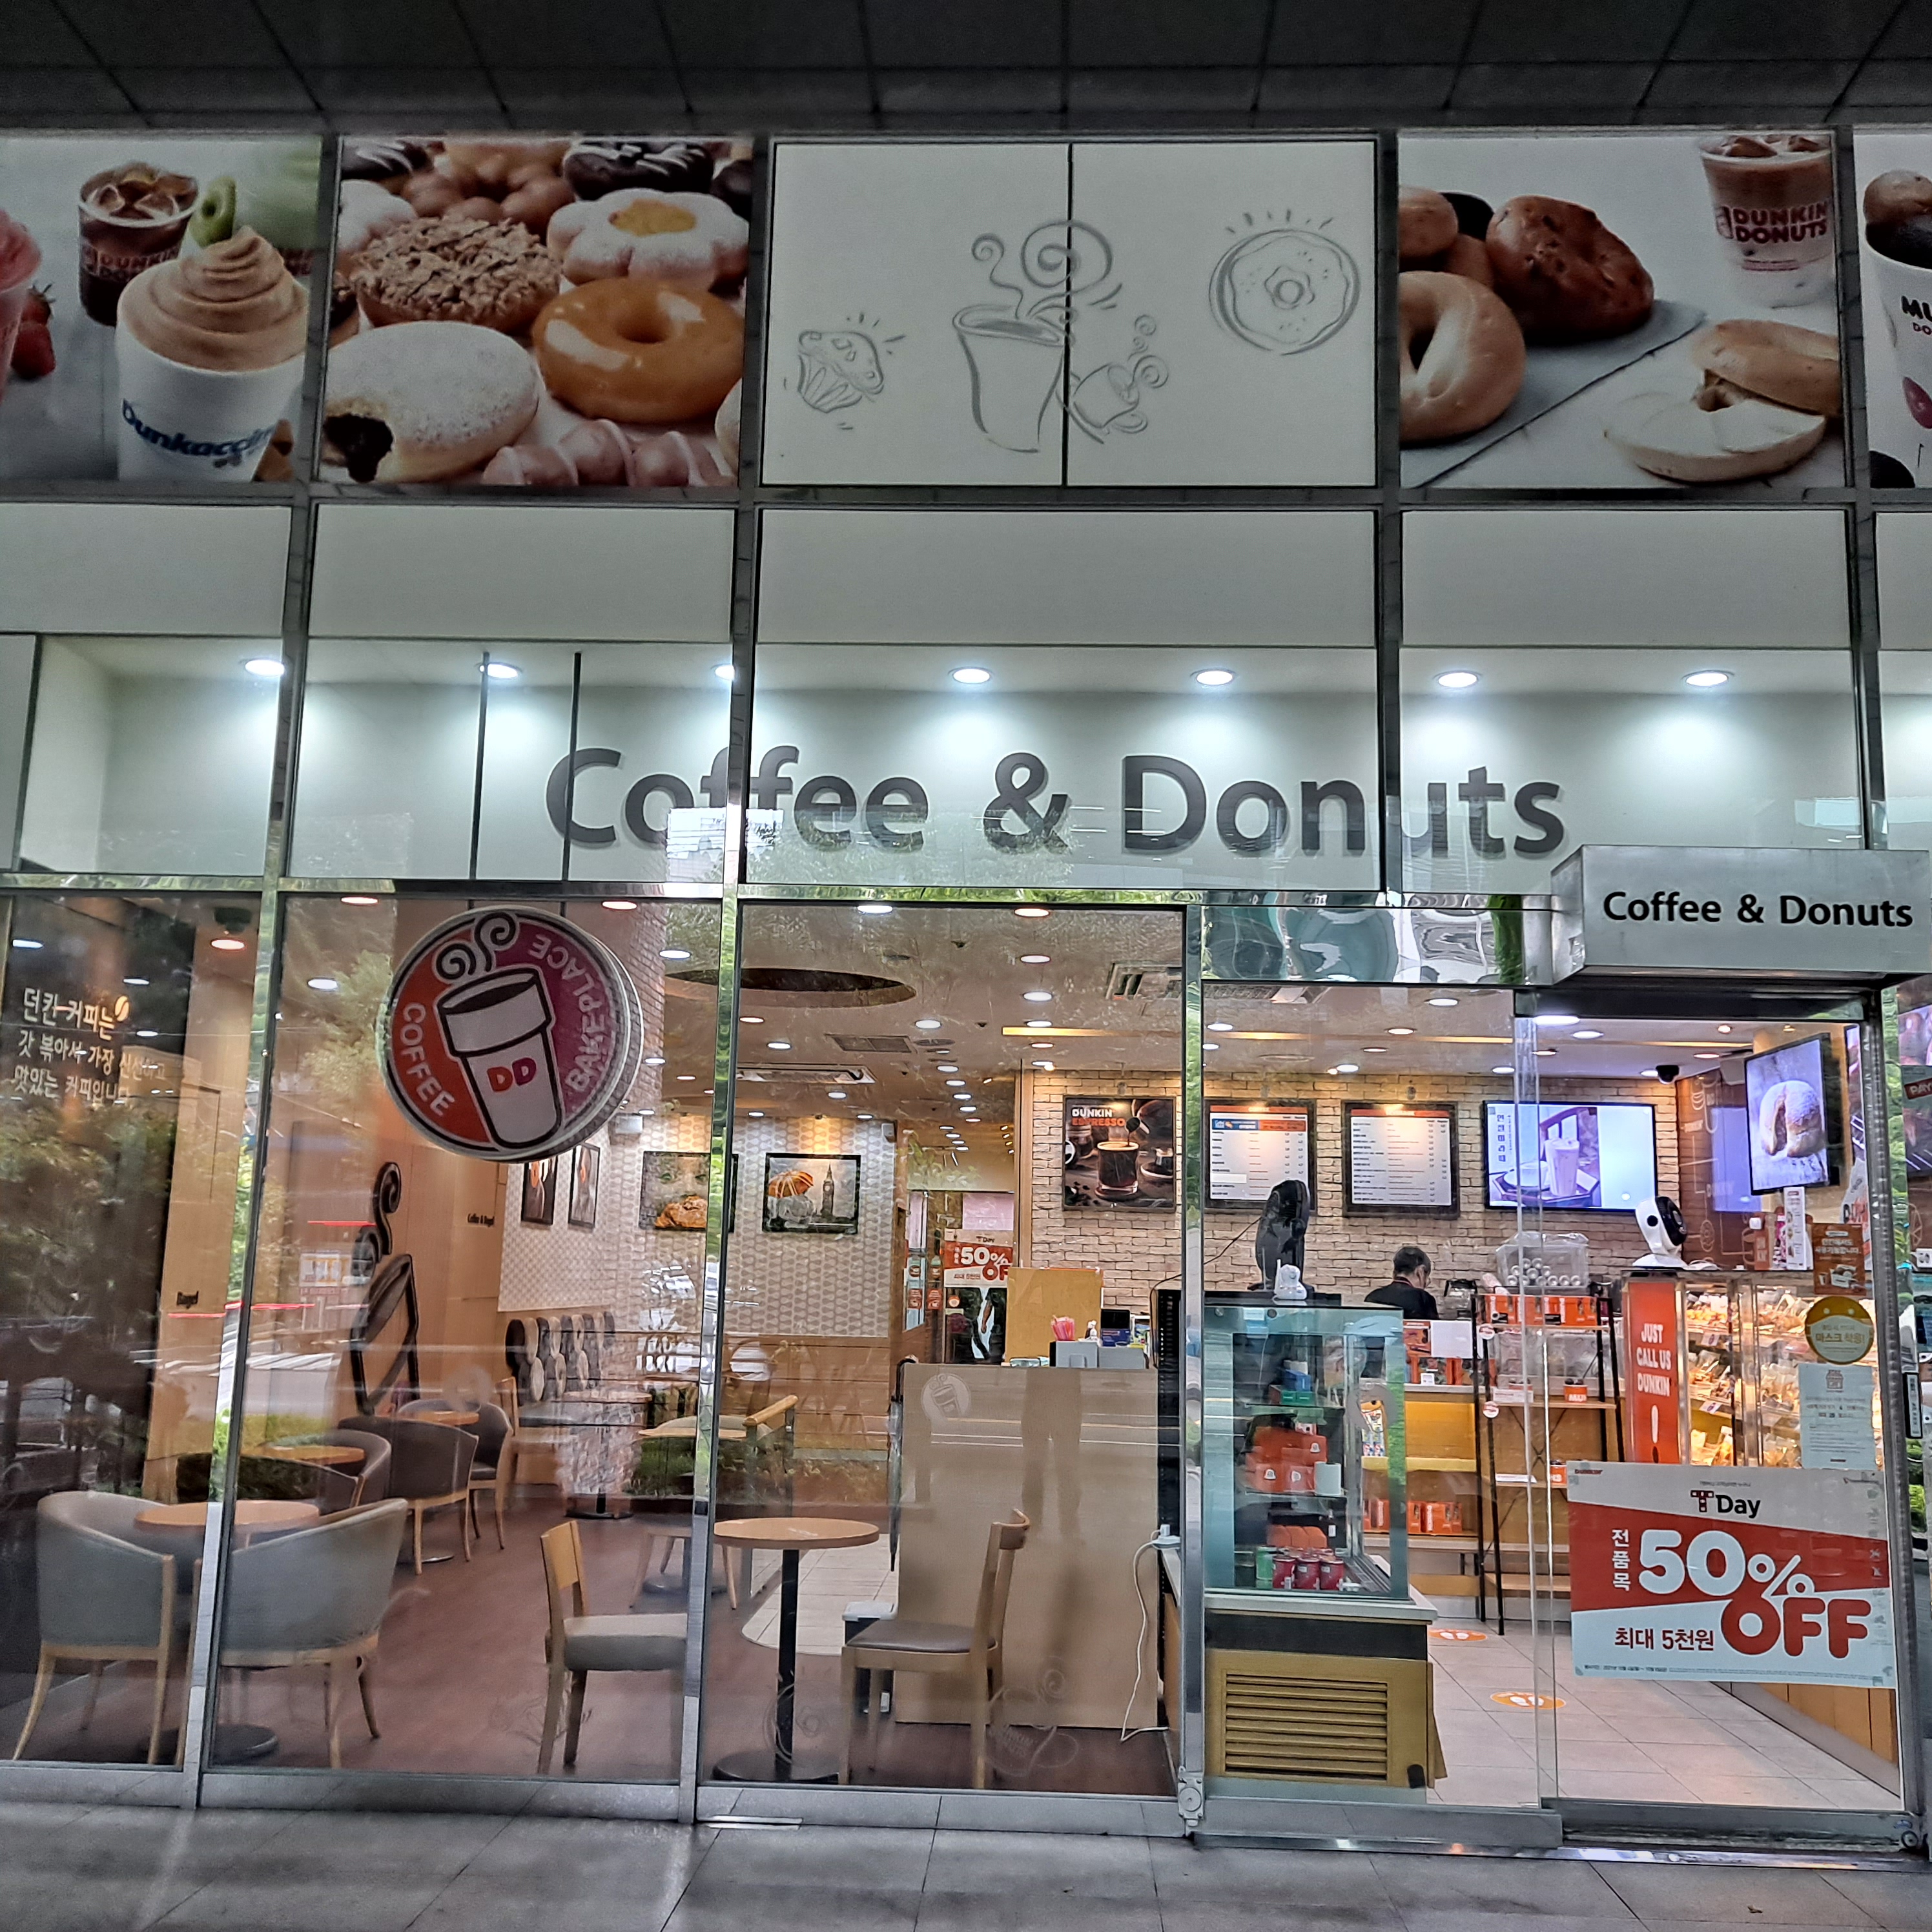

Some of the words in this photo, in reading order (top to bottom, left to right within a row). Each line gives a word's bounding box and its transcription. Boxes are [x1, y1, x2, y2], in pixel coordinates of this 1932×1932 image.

[1732, 203, 1827, 225] DUNKIN
[1735, 220, 1827, 243] DONUTS
[546, 745, 929, 850] Coffee
[984, 753, 1071, 850] &
[1123, 755, 1565, 857] Donuts
[1603, 891, 1721, 922] Coffee
[1737, 894, 1765, 923] &
[1780, 895, 1913, 927] Donuts
[24, 987, 57, 1027] 던킨
[67, 1000, 115, 1041] 커피는
[19, 1030, 35, 1058] 갓
[88, 1046, 115, 1076] 가장
[400, 1002, 455, 1116] COFFEE
[14, 1065, 59, 1099] 맛있는
[486, 1057, 537, 1092] DD
[1072, 1109, 1113, 1117] DUNKIN
[1072, 1118, 1125, 1127] ESPRESSO
[961, 1246, 1009, 1265] 50%
[1641, 1323, 1663, 1344] JUST
[1636, 1347, 1658, 1368] CALL
[1659, 1350, 1672, 1370] US
[1637, 1372, 1670, 1397] DUNKIN
[1639, 1528, 1815, 1597] 50%
[1615, 1628, 1654, 1651] 최대
[1663, 1629, 1714, 1652] 5천원
[1721, 1595, 1871, 1658] OFF
